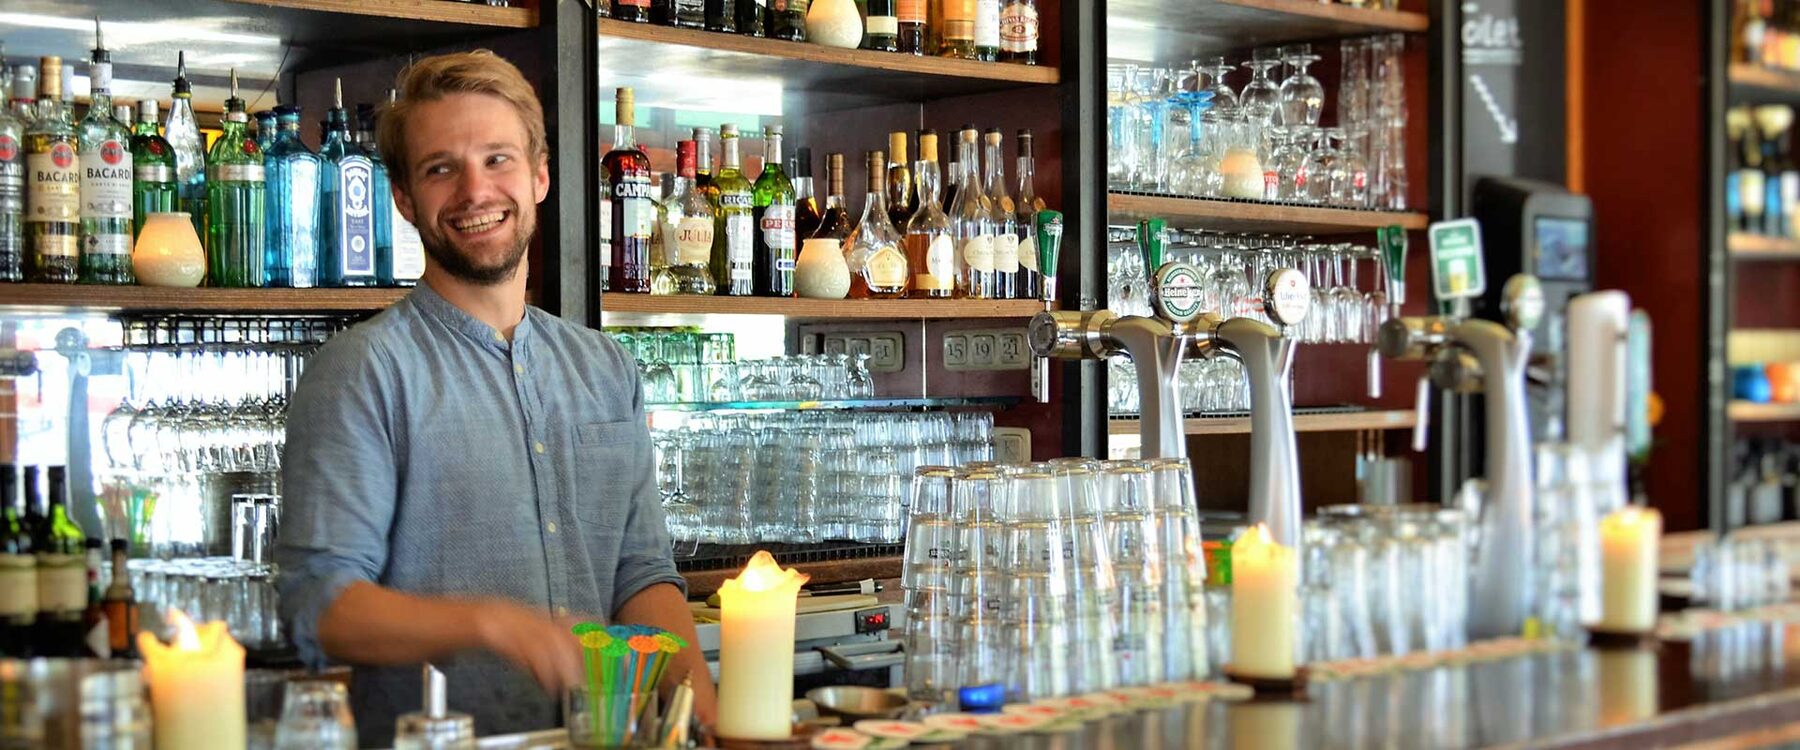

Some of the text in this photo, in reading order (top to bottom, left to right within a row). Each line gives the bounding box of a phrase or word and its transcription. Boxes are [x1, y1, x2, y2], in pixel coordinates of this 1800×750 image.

[1163, 287, 1201, 298] Heineken
[948, 342, 1019, 358] 15 19 21
